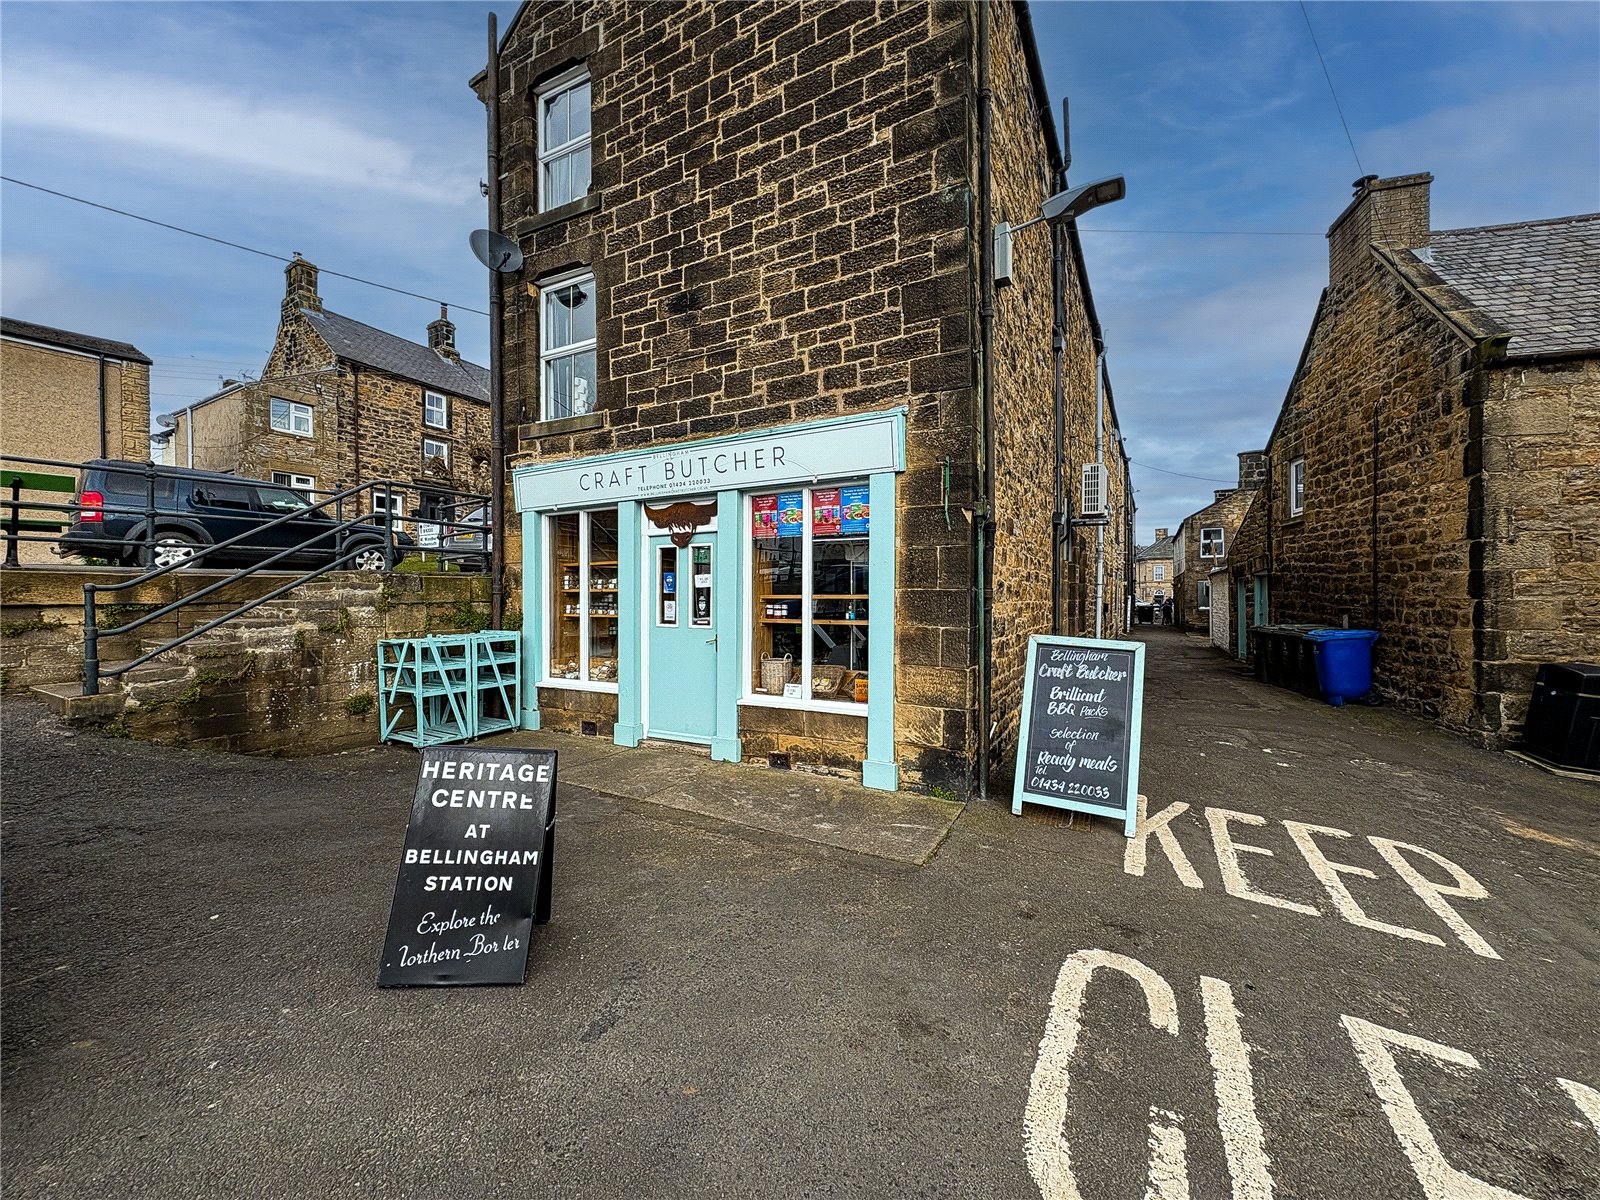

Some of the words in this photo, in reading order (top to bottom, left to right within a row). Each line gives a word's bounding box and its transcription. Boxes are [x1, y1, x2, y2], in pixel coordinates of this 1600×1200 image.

[652, 450, 690, 460] BELLINGHAM
[579, 465, 647, 491] CRAFT
[664, 446, 786, 480] BUTCHER
[637, 483, 667, 492] TELEPHONE
[668, 480, 687, 488] 01434
[688, 478, 711, 486] 220033
[1050, 649, 1109, 666] Bellingham
[1038, 663, 1074, 680] Craft
[1076, 664, 1127, 682] Butcher
[1049, 686, 1107, 703] Brilliant
[1047, 701, 1076, 716] BBQ
[1079, 705, 1109, 718] Packs
[1065, 740, 1077, 753] of
[1034, 765, 1048, 775] Tel.
[1037, 751, 1077, 773] Ready
[1078, 755, 1118, 773] meals
[421, 760, 550, 783] HERITAGE
[1031, 776, 1065, 793] 01434
[1067, 782, 1110, 799] 220033
[431, 788, 534, 810] CENTRE
[464, 824, 491, 839] AT
[404, 849, 539, 865] BELLINGHAM
[423, 876, 513, 892] STATION
[1122, 794, 1505, 962] KEEP
[416, 909, 476, 936] Explore
[479, 904, 501, 925] the
